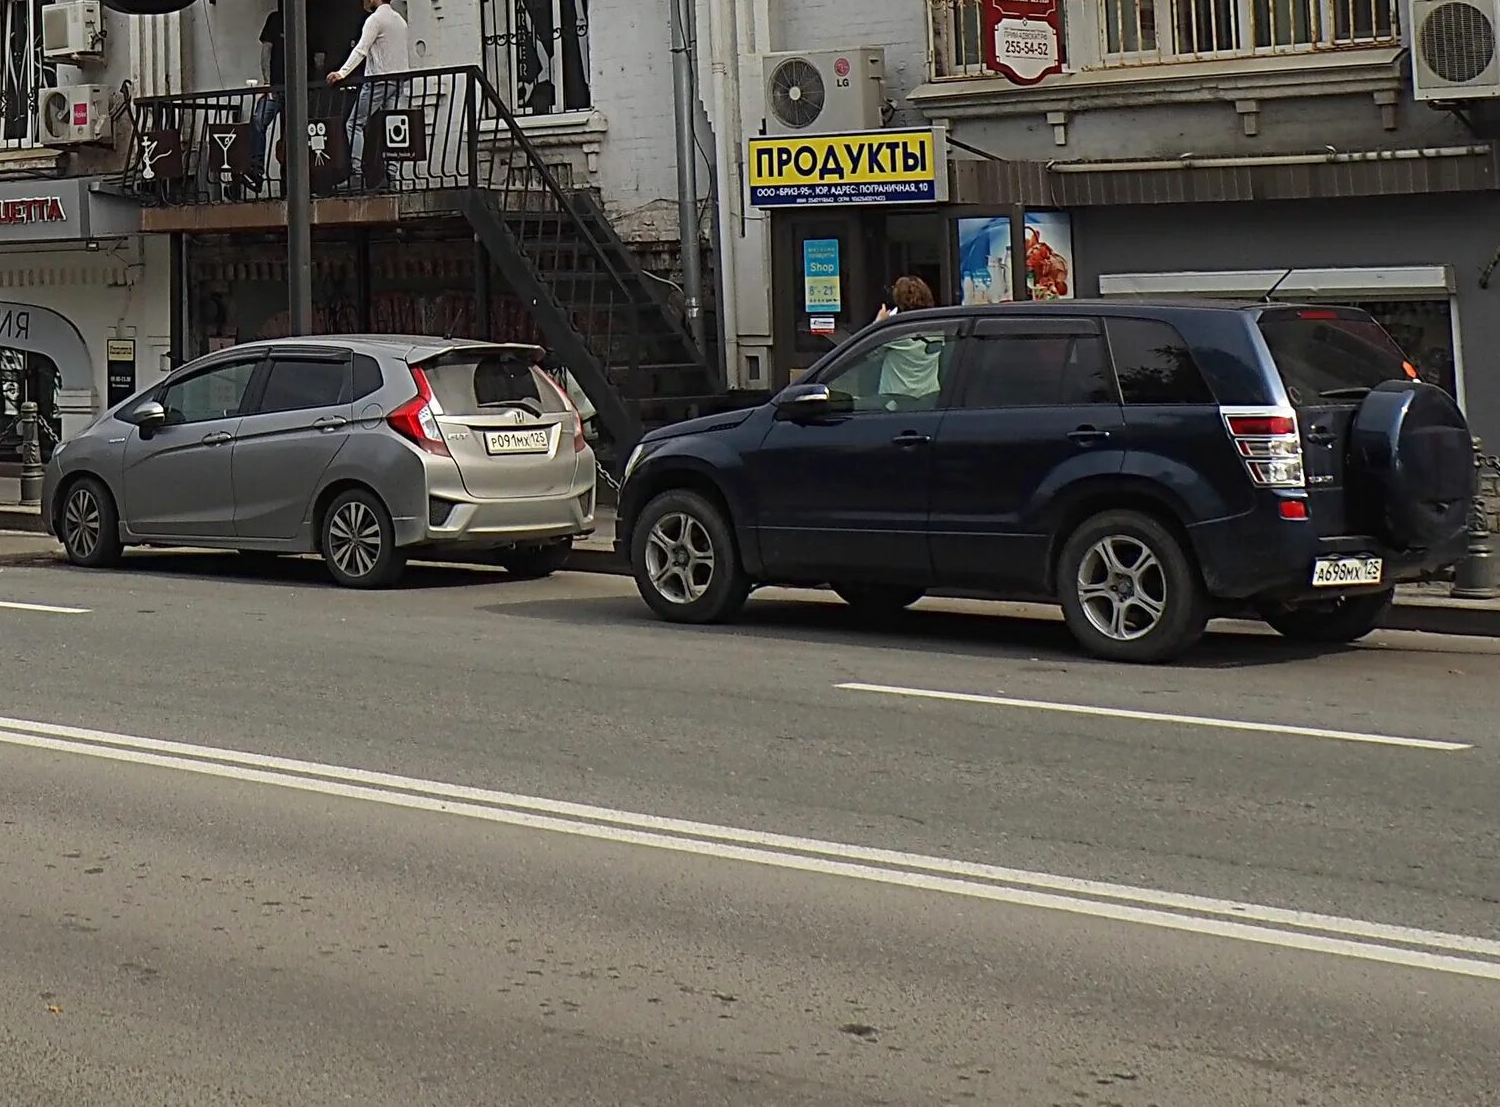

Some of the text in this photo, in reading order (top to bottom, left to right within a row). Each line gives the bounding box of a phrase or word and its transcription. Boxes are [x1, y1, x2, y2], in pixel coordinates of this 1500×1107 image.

[1005, 40, 1049, 56] 255-54-52
[836, 78, 850, 88] LG
[756, 140, 927, 181] ПРОДУКТЫ
[756, 187, 776, 197] ООО
[815, 185, 830, 195] ЮР.
[830, 185, 858, 195] АДРЕС:
[859, 182, 918, 193] ПОГРАНИЧНАЯ,
[919, 182, 928, 192] 10
[810, 262, 835, 274] Shop
